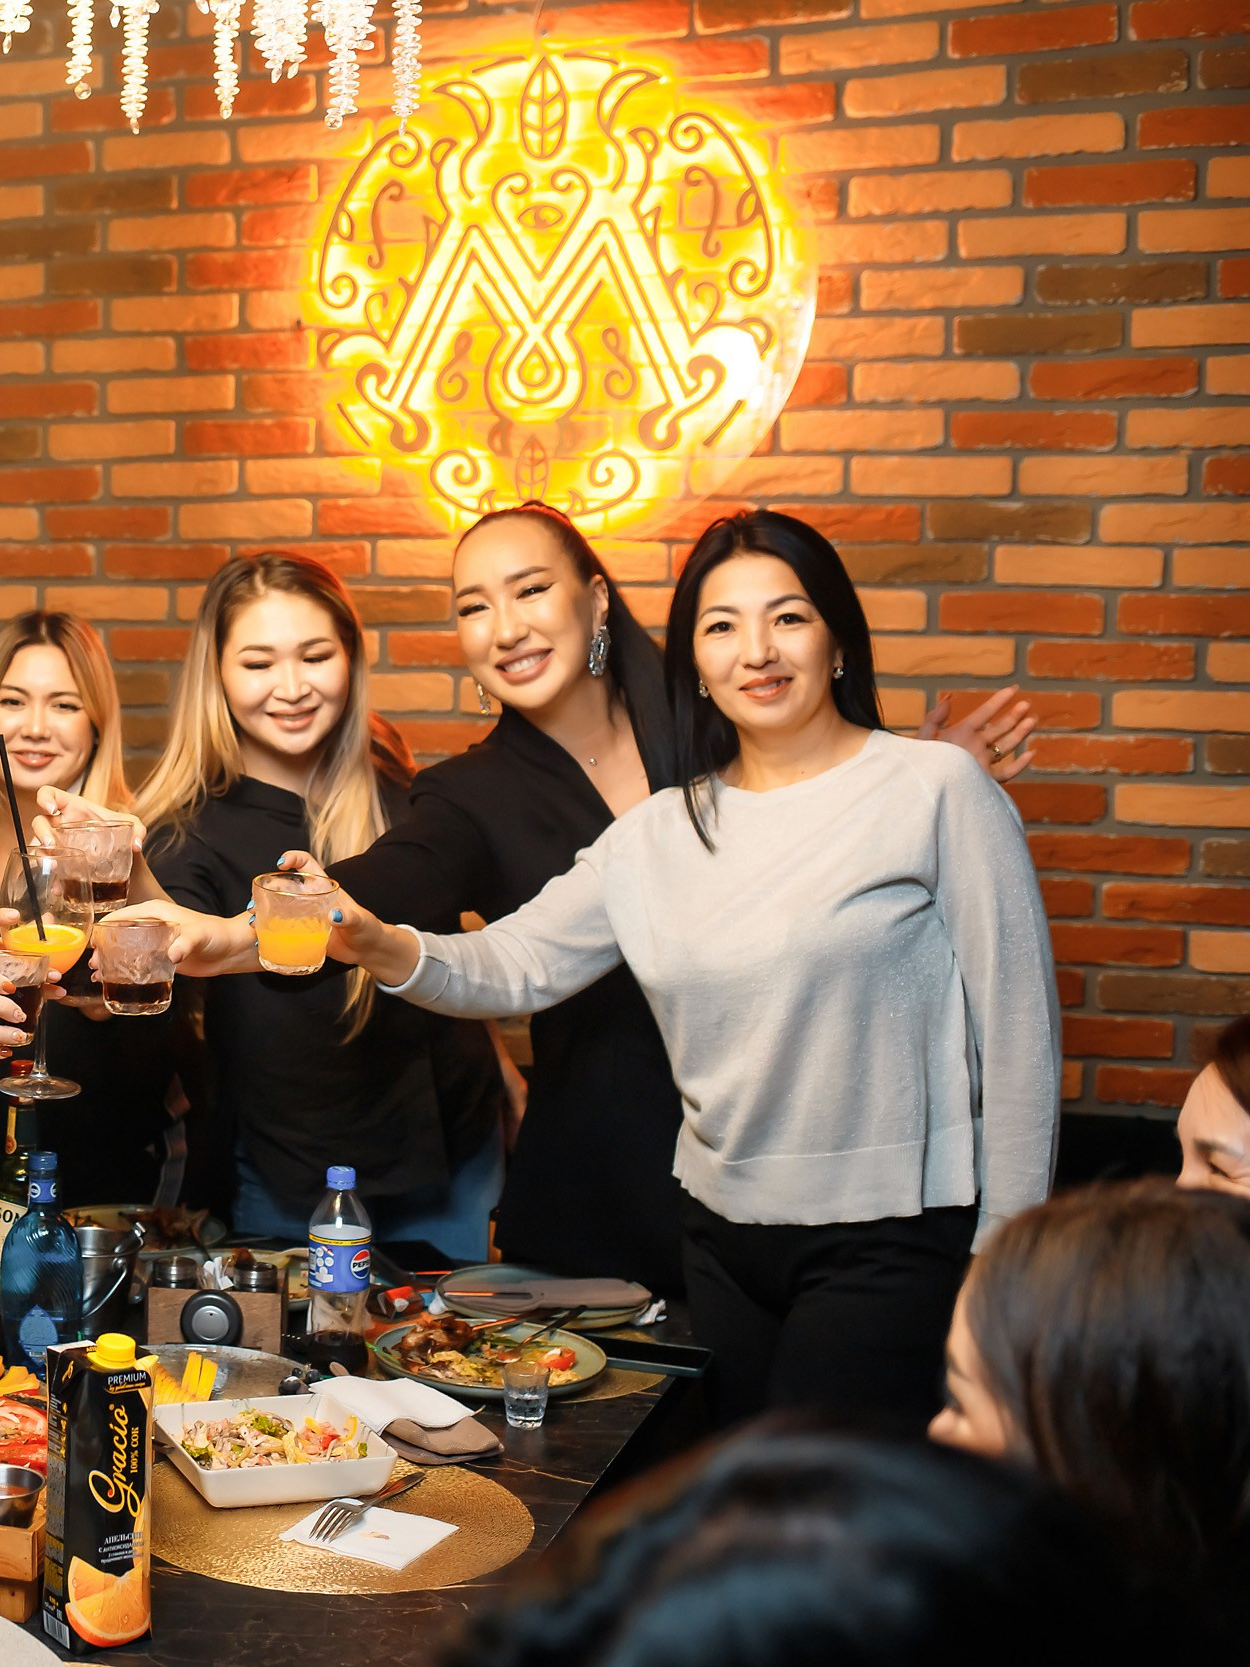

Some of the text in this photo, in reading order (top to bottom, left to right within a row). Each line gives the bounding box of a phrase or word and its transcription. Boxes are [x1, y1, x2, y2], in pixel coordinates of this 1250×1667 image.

[107, 1371, 147, 1386] PREMIUM
[130, 1426, 139, 1474] 100% СОК
